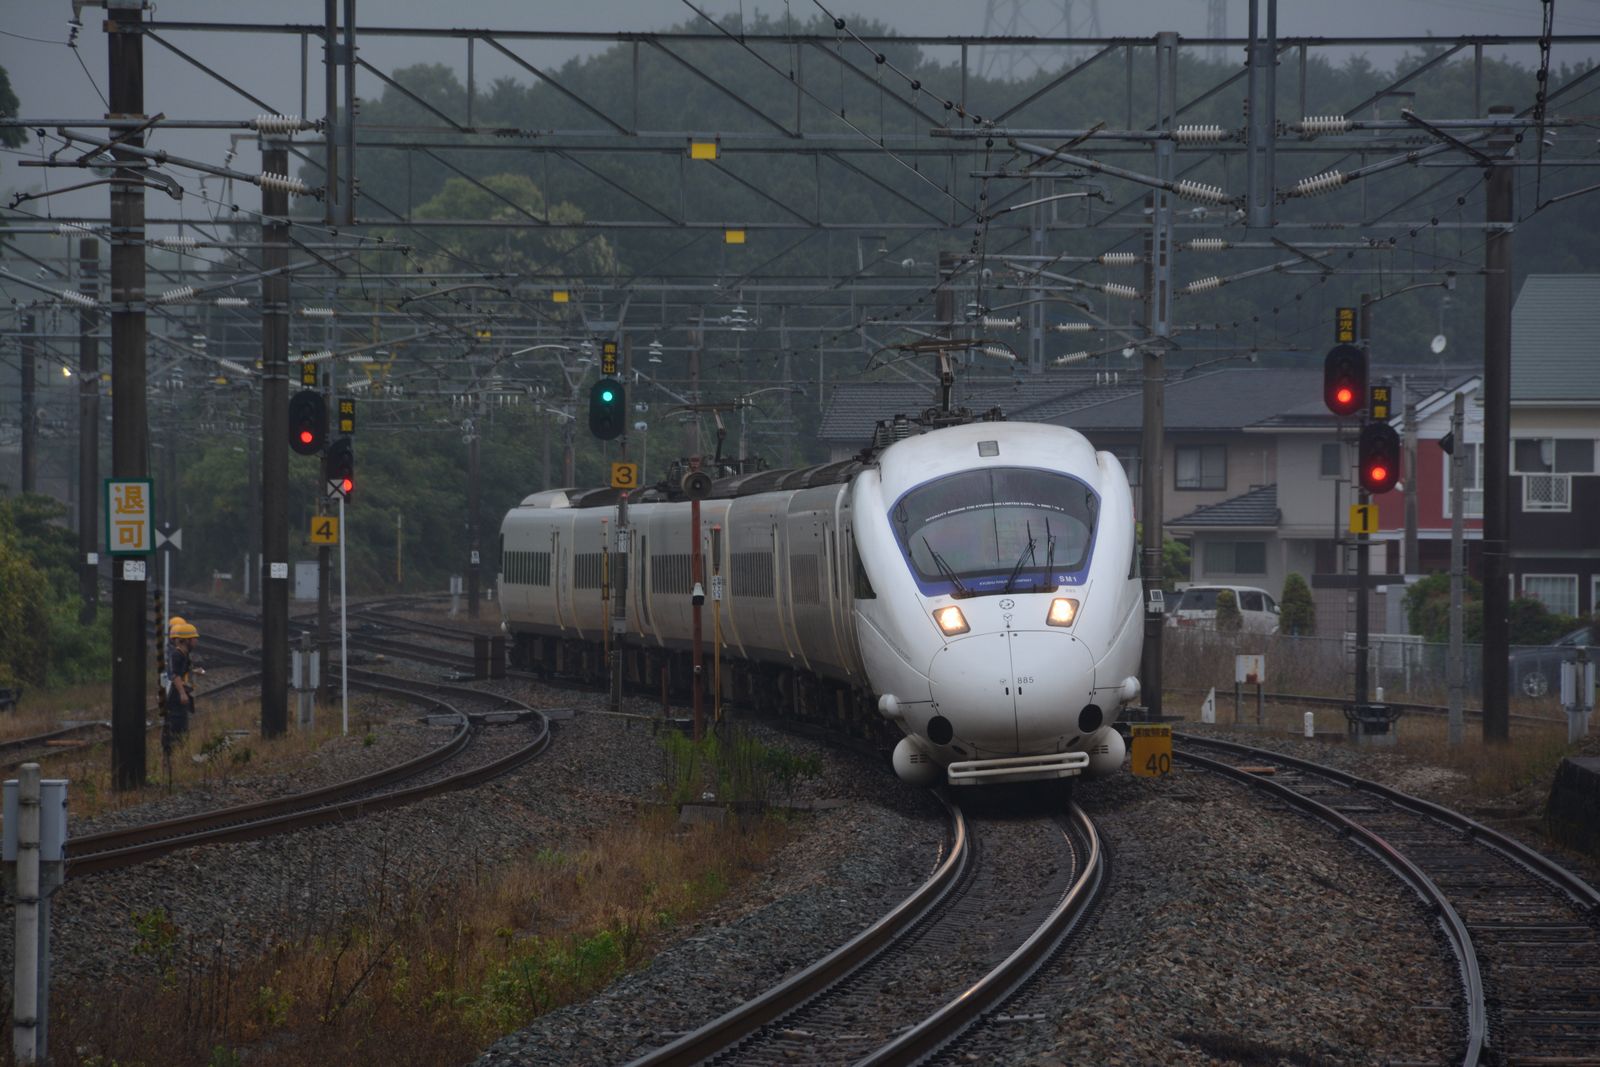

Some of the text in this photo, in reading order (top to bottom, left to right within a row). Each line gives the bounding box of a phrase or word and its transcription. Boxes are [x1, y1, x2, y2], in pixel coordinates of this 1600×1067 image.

[616, 466, 633, 484] 3
[115, 485, 145, 548] 退可
[1357, 507, 1368, 531] 1
[316, 521, 333, 541] 4
[1058, 575, 1077, 583] SM1
[1017, 676, 1034, 684] 885
[1207, 699, 1213, 713] 1
[1146, 753, 1170, 776] 40
